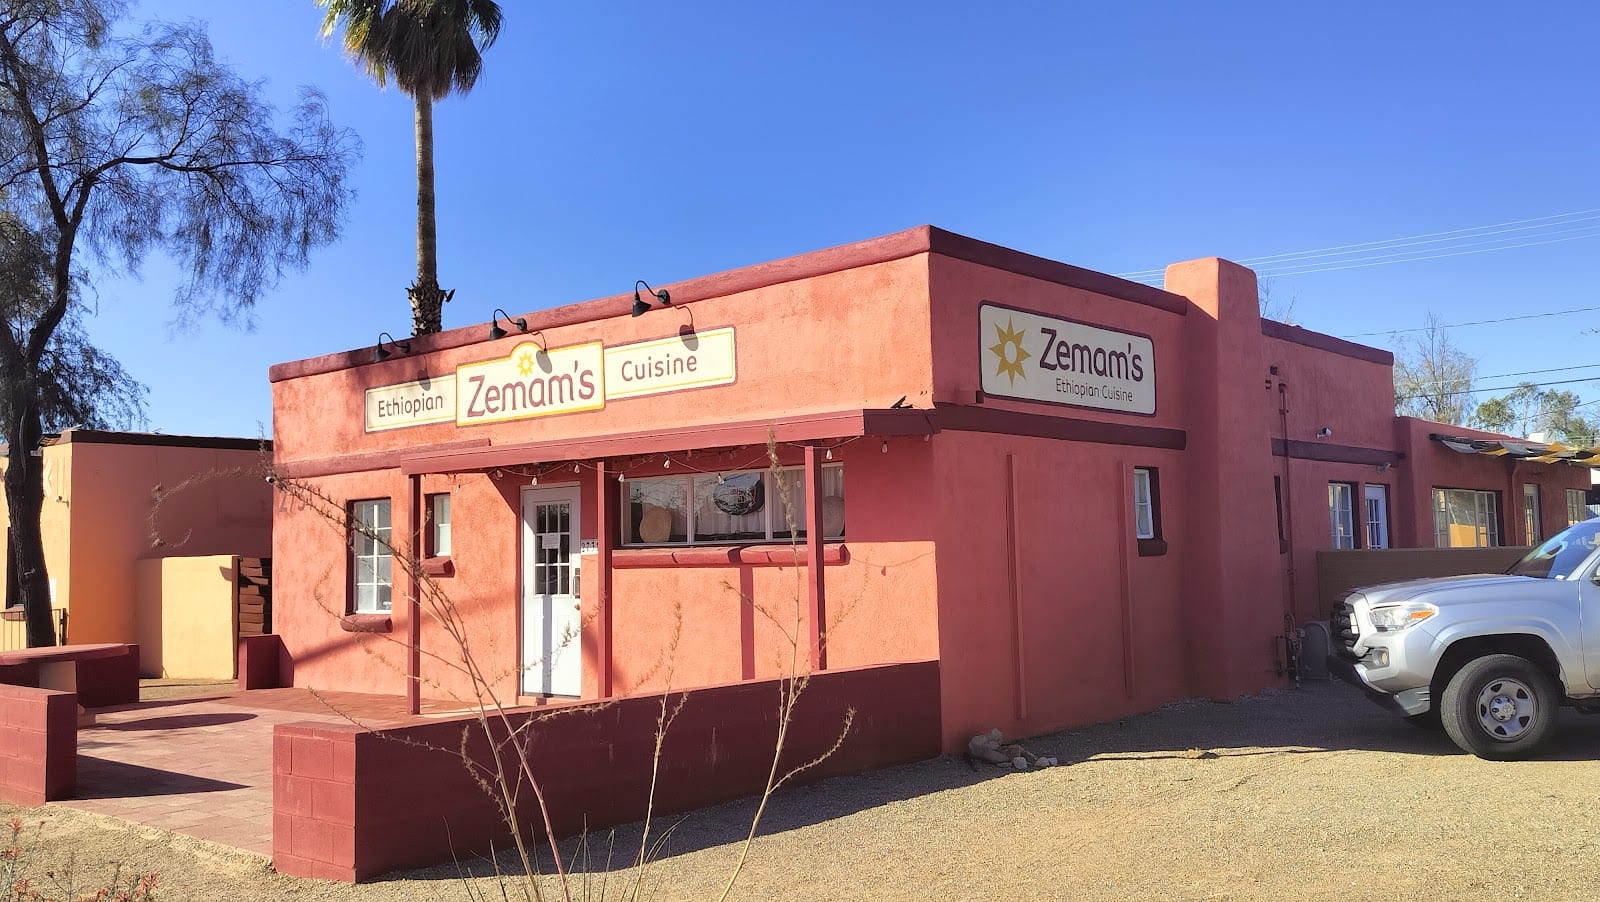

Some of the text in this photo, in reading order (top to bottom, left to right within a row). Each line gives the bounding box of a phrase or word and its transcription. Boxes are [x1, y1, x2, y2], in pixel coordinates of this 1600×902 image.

[1039, 327, 1143, 382] Zemam's
[378, 352, 698, 418] Ethiopian Zemam's Cuisine
[1055, 378, 1133, 402] Ethiopian Cuisine
